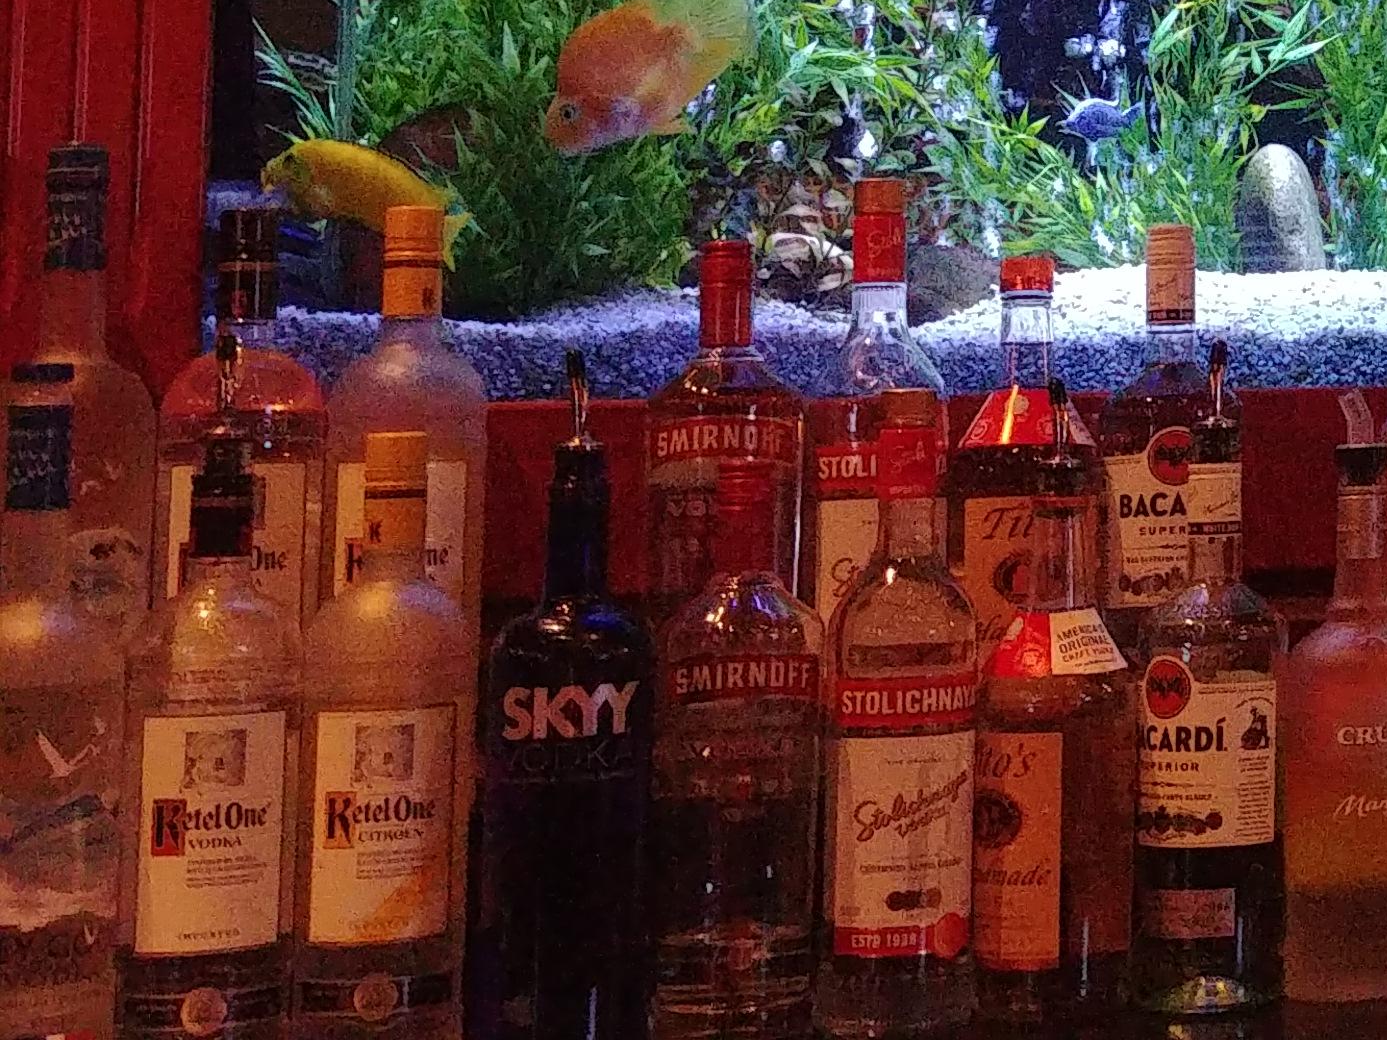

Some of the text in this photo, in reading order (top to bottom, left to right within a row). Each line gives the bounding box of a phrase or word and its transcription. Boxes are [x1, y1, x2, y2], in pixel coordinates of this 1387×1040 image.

[818, 454, 877, 480] STOLI
[1120, 492, 1186, 519] BACA
[1139, 525, 1186, 536] SUPER
[676, 658, 810, 694] SMIRNOFF
[502, 680, 640, 741] SKYY
[155, 801, 267, 849] Ketel One
[326, 795, 436, 844] Ketel One
[188, 835, 242, 849] VODKA
